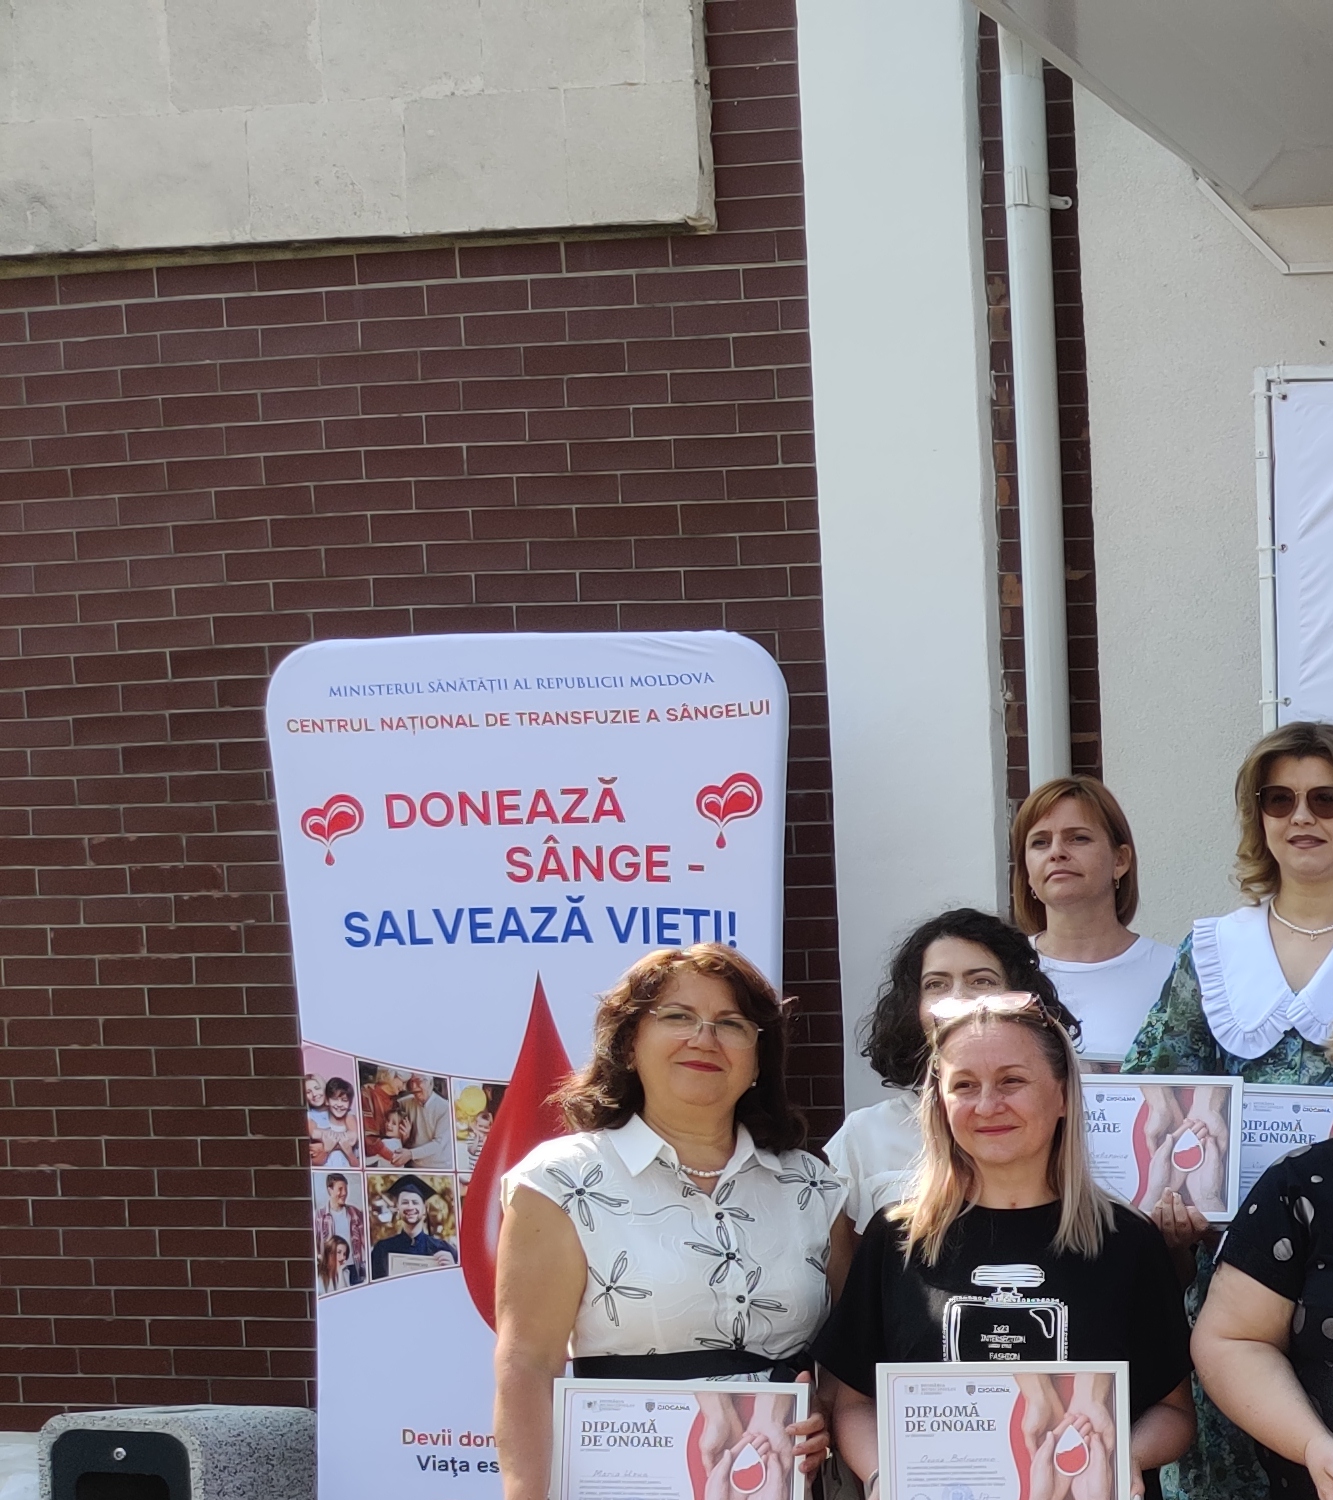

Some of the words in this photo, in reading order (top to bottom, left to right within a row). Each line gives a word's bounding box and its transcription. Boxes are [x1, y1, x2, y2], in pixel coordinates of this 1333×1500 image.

[329, 681, 425, 698] MINISTERUL
[513, 678, 532, 690] AL
[536, 676, 625, 690] REPUBLICII
[630, 672, 715, 688] MOLDOVA
[286, 717, 376, 733] CENTRUL
[484, 712, 511, 727] DE
[515, 709, 641, 727] TRANSFUZIE
[645, 708, 660, 723] A
[665, 699, 770, 722] SÂNGELUI
[385, 776, 626, 829] DONEAZĂ
[505, 834, 672, 883] SÂNGE
[344, 895, 594, 948] SALVEAZĂ
[905, 1402, 980, 1418] DIPLOMĂ
[581, 1419, 657, 1433] DIPLOMĂ
[905, 1420, 926, 1432] DE
[930, 1420, 996, 1432] ONOARE
[402, 1429, 452, 1446] Devii
[580, 1434, 602, 1447] DE
[606, 1435, 674, 1448] ONOARE
